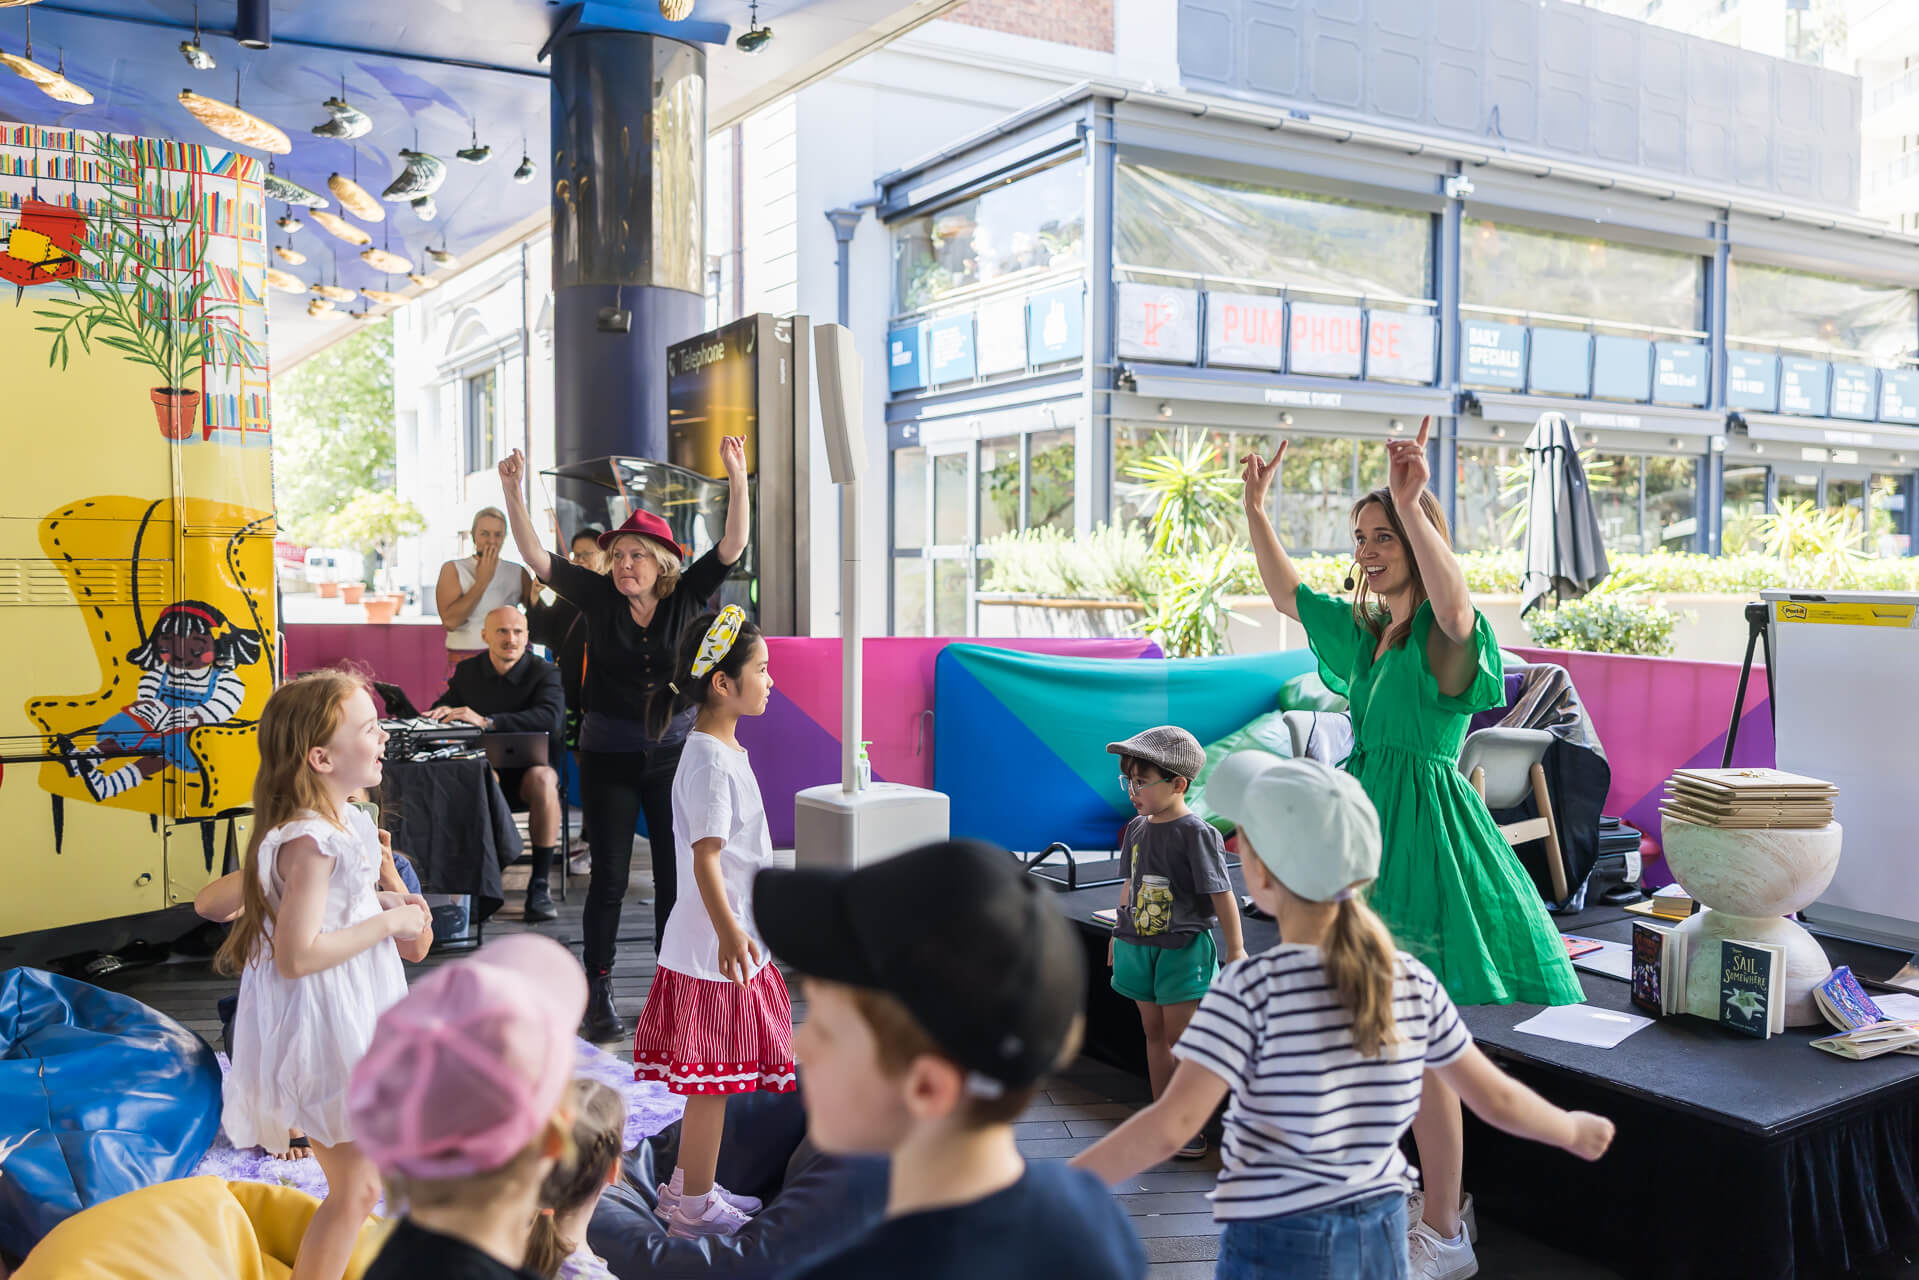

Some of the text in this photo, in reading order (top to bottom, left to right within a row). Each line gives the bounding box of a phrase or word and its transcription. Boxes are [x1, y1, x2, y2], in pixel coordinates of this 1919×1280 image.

[680, 341, 725, 374] Telephone
[1469, 347, 1521, 368] SPECIALS
[1733, 955, 1758, 975] SAIL
